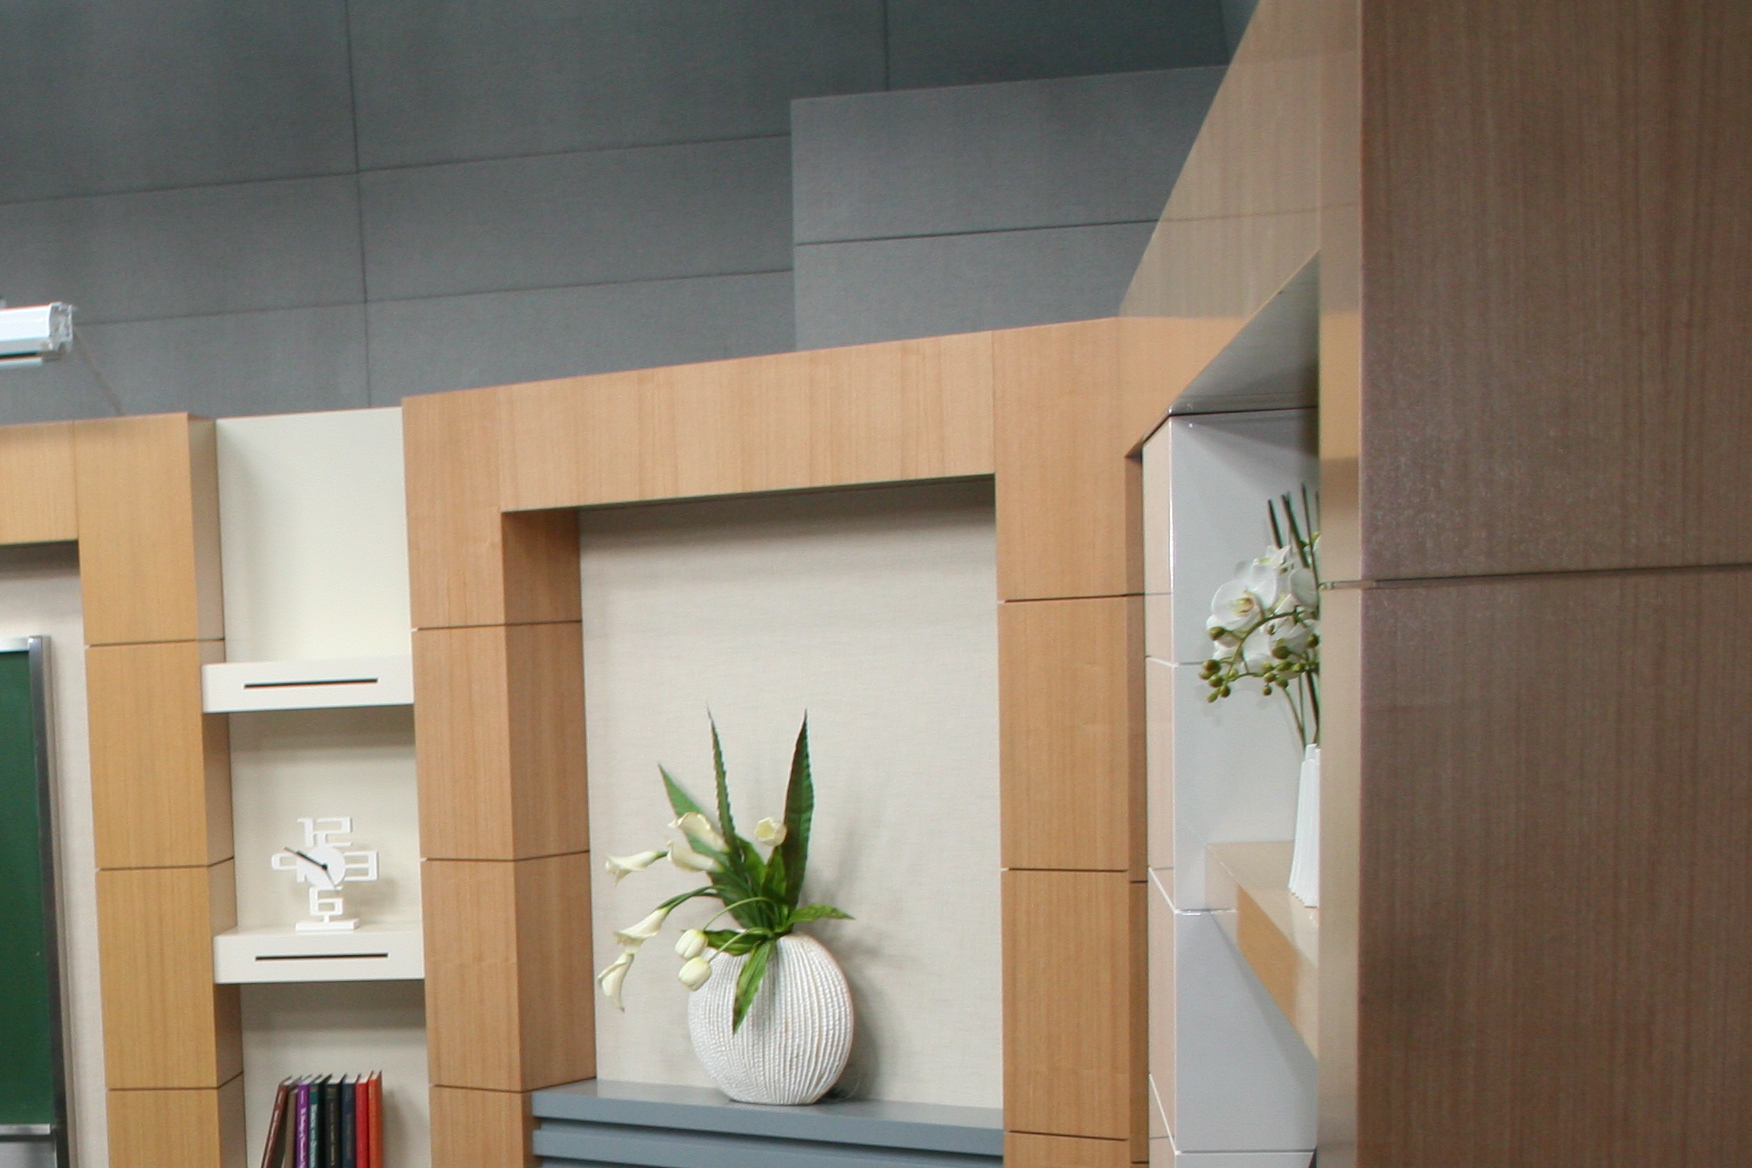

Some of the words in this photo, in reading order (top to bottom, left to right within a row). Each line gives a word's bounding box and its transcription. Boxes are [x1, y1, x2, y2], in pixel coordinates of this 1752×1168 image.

[297, 817, 353, 847] 12
[344, 851, 379, 881] 3
[308, 887, 343, 916] 6
